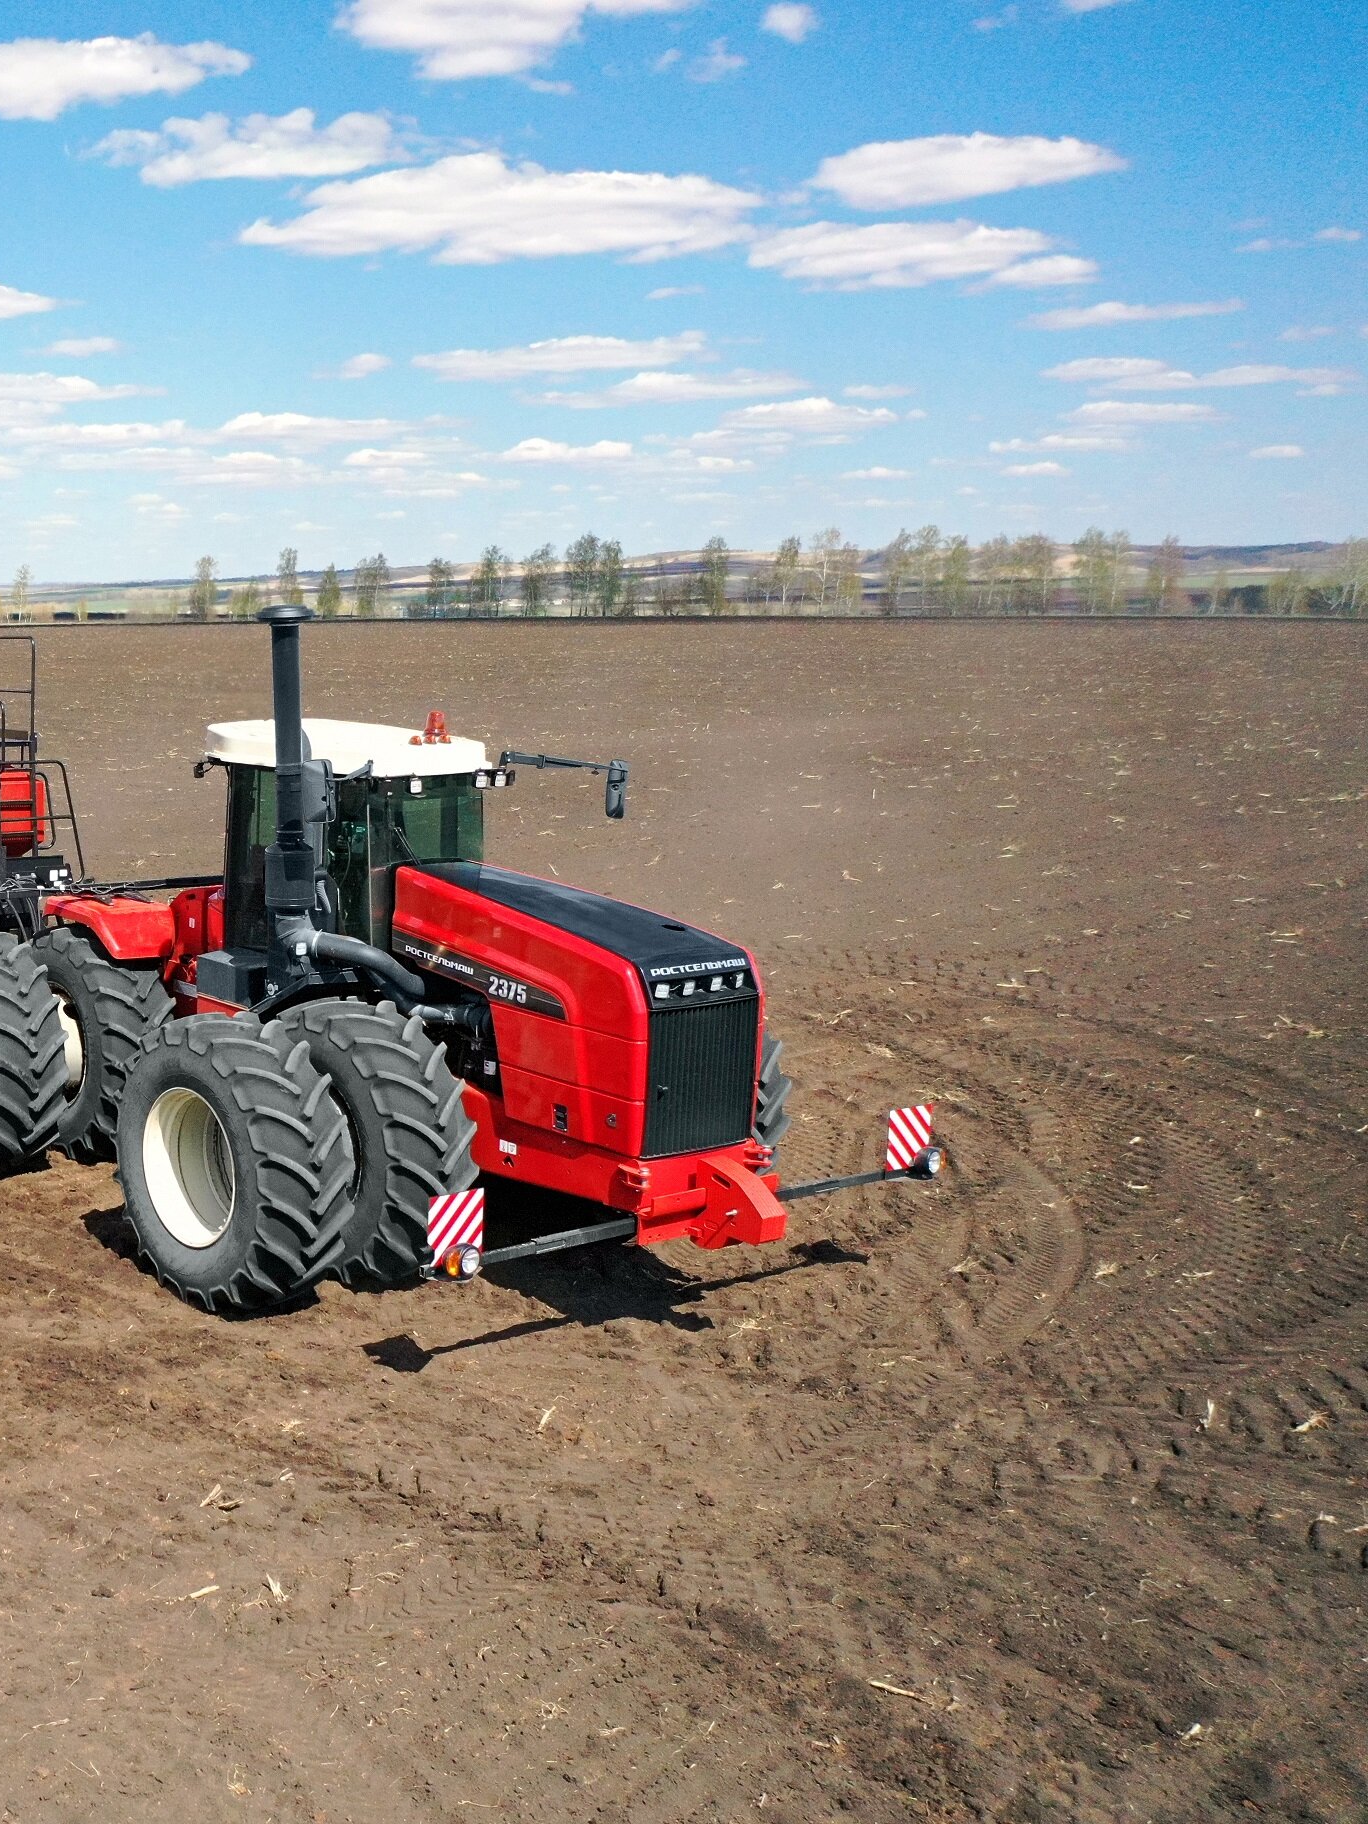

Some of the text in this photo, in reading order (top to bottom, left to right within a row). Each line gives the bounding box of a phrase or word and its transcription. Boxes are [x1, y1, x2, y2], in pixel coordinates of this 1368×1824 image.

[405, 945, 527, 1004] РОСТСЕЛЬМАШ 2375
[650, 958, 746, 976] РОСТСЕЛЬМАШ
